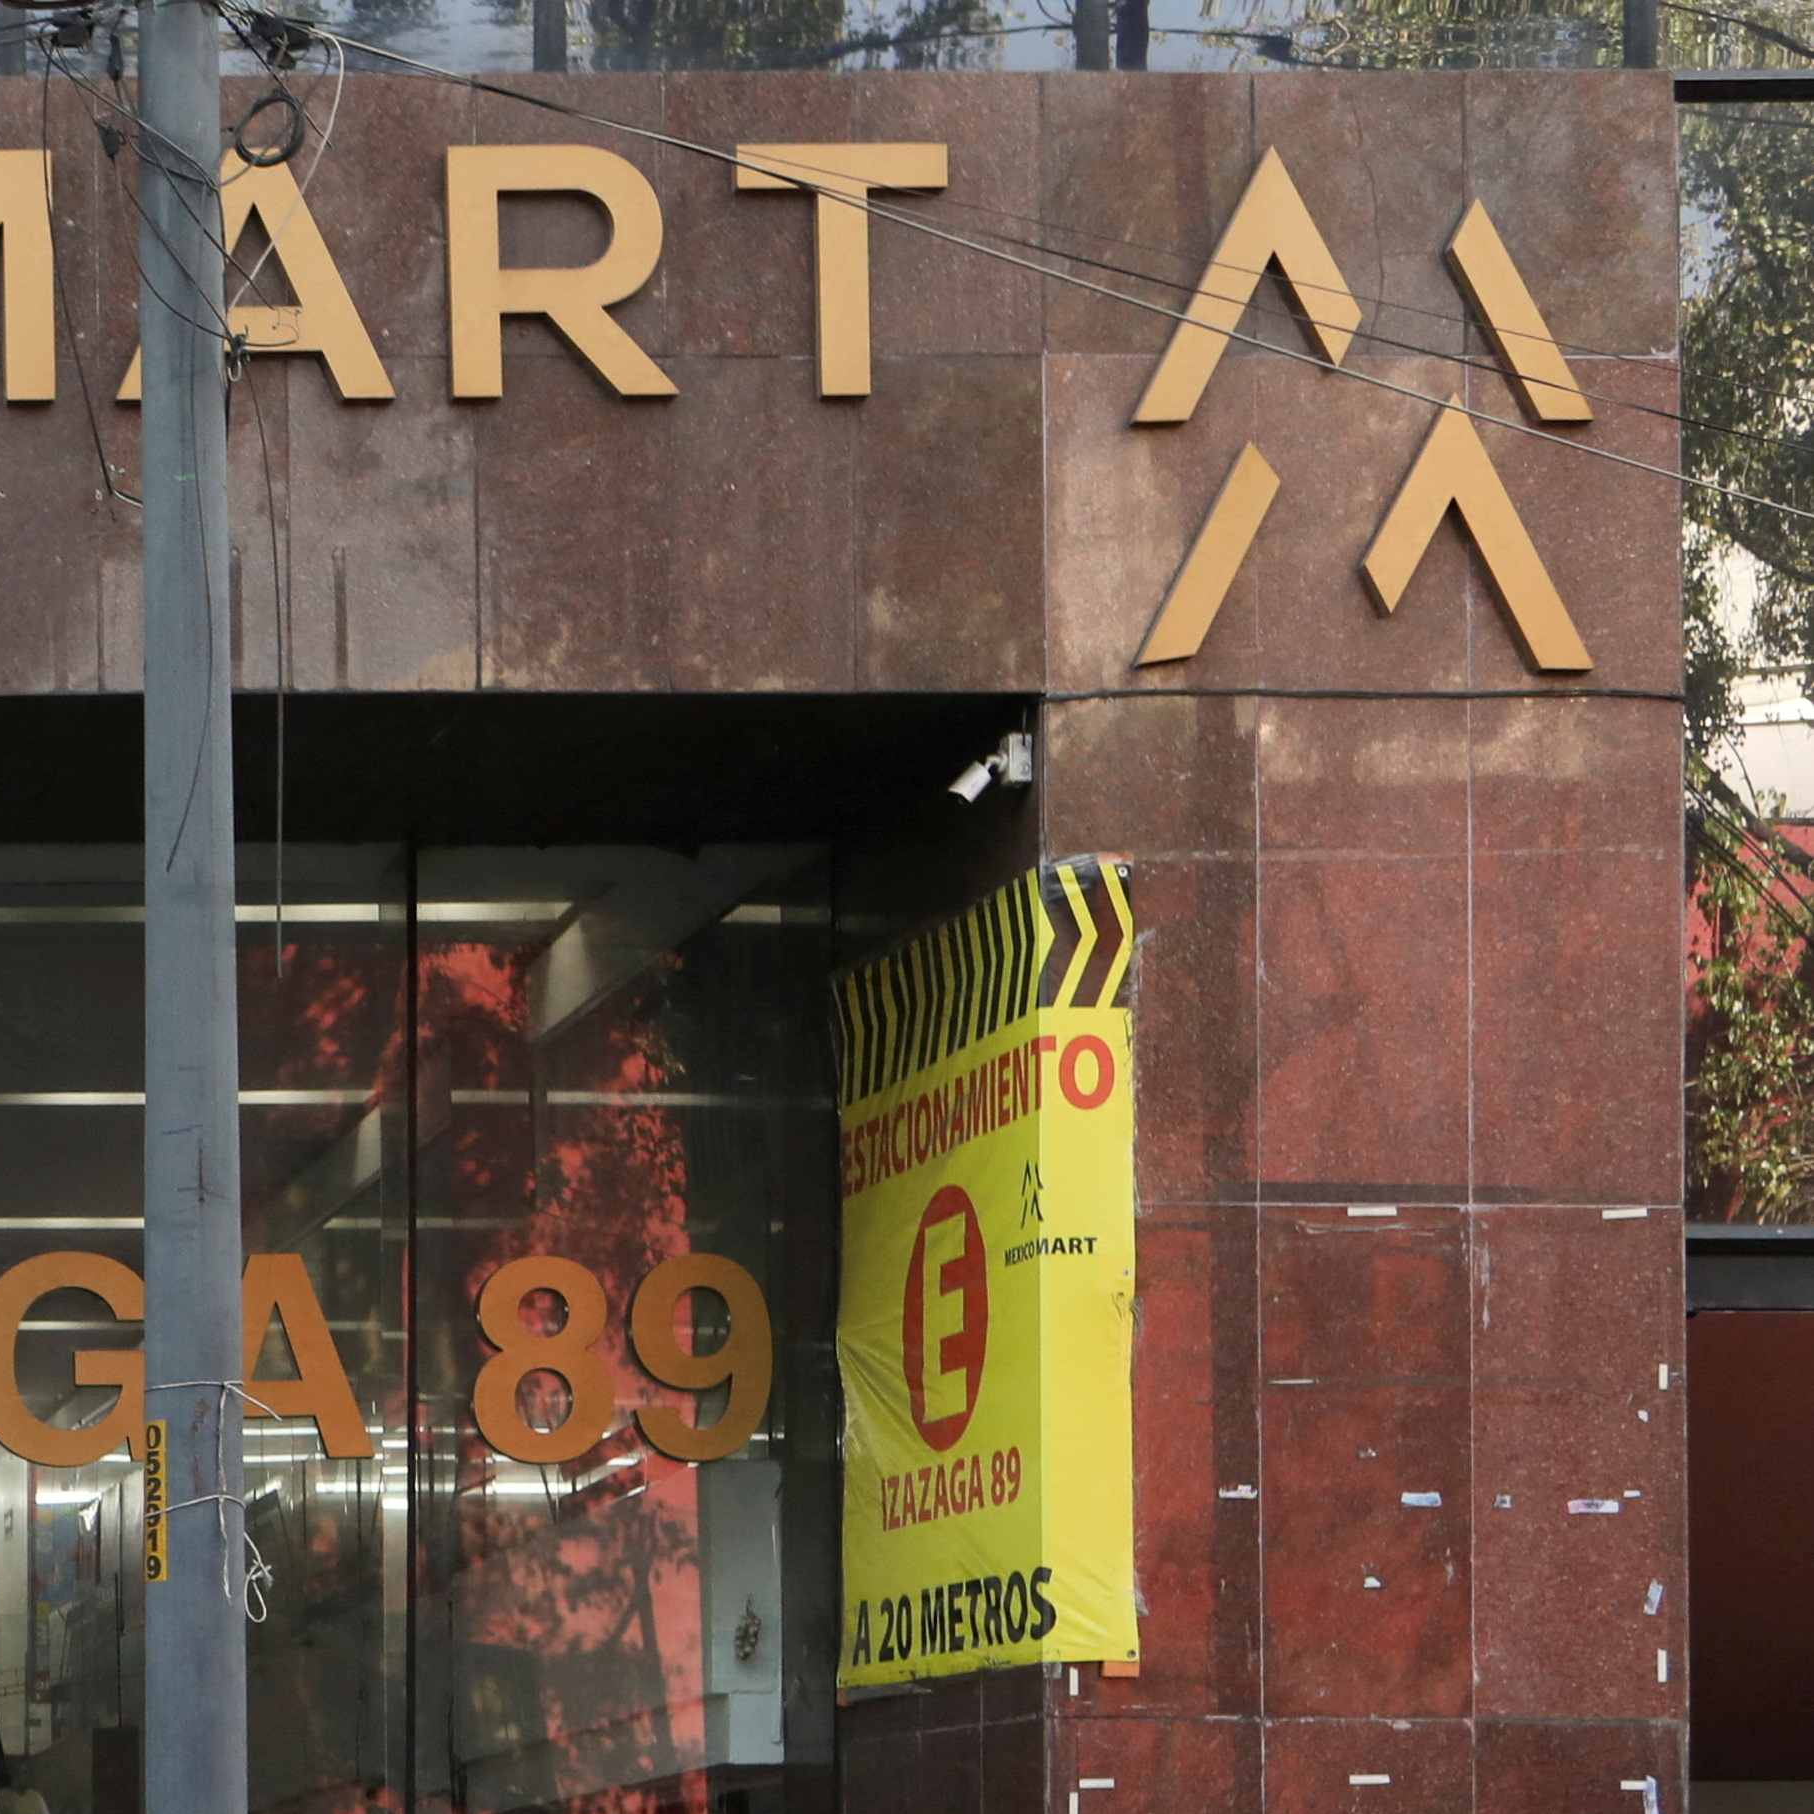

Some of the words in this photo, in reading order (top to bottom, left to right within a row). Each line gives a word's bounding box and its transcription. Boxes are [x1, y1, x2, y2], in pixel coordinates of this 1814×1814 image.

[842, 1034, 1115, 1199] ESTACIONAMIENTO
[472, 1251, 773, 1467] 89
[881, 1455, 985, 1531] IZAZAGA
[990, 1446, 1022, 1507] 89
[852, 1600, 872, 1667] A
[878, 1594, 913, 1664] 20
[920, 1566, 1057, 1657] METROS
